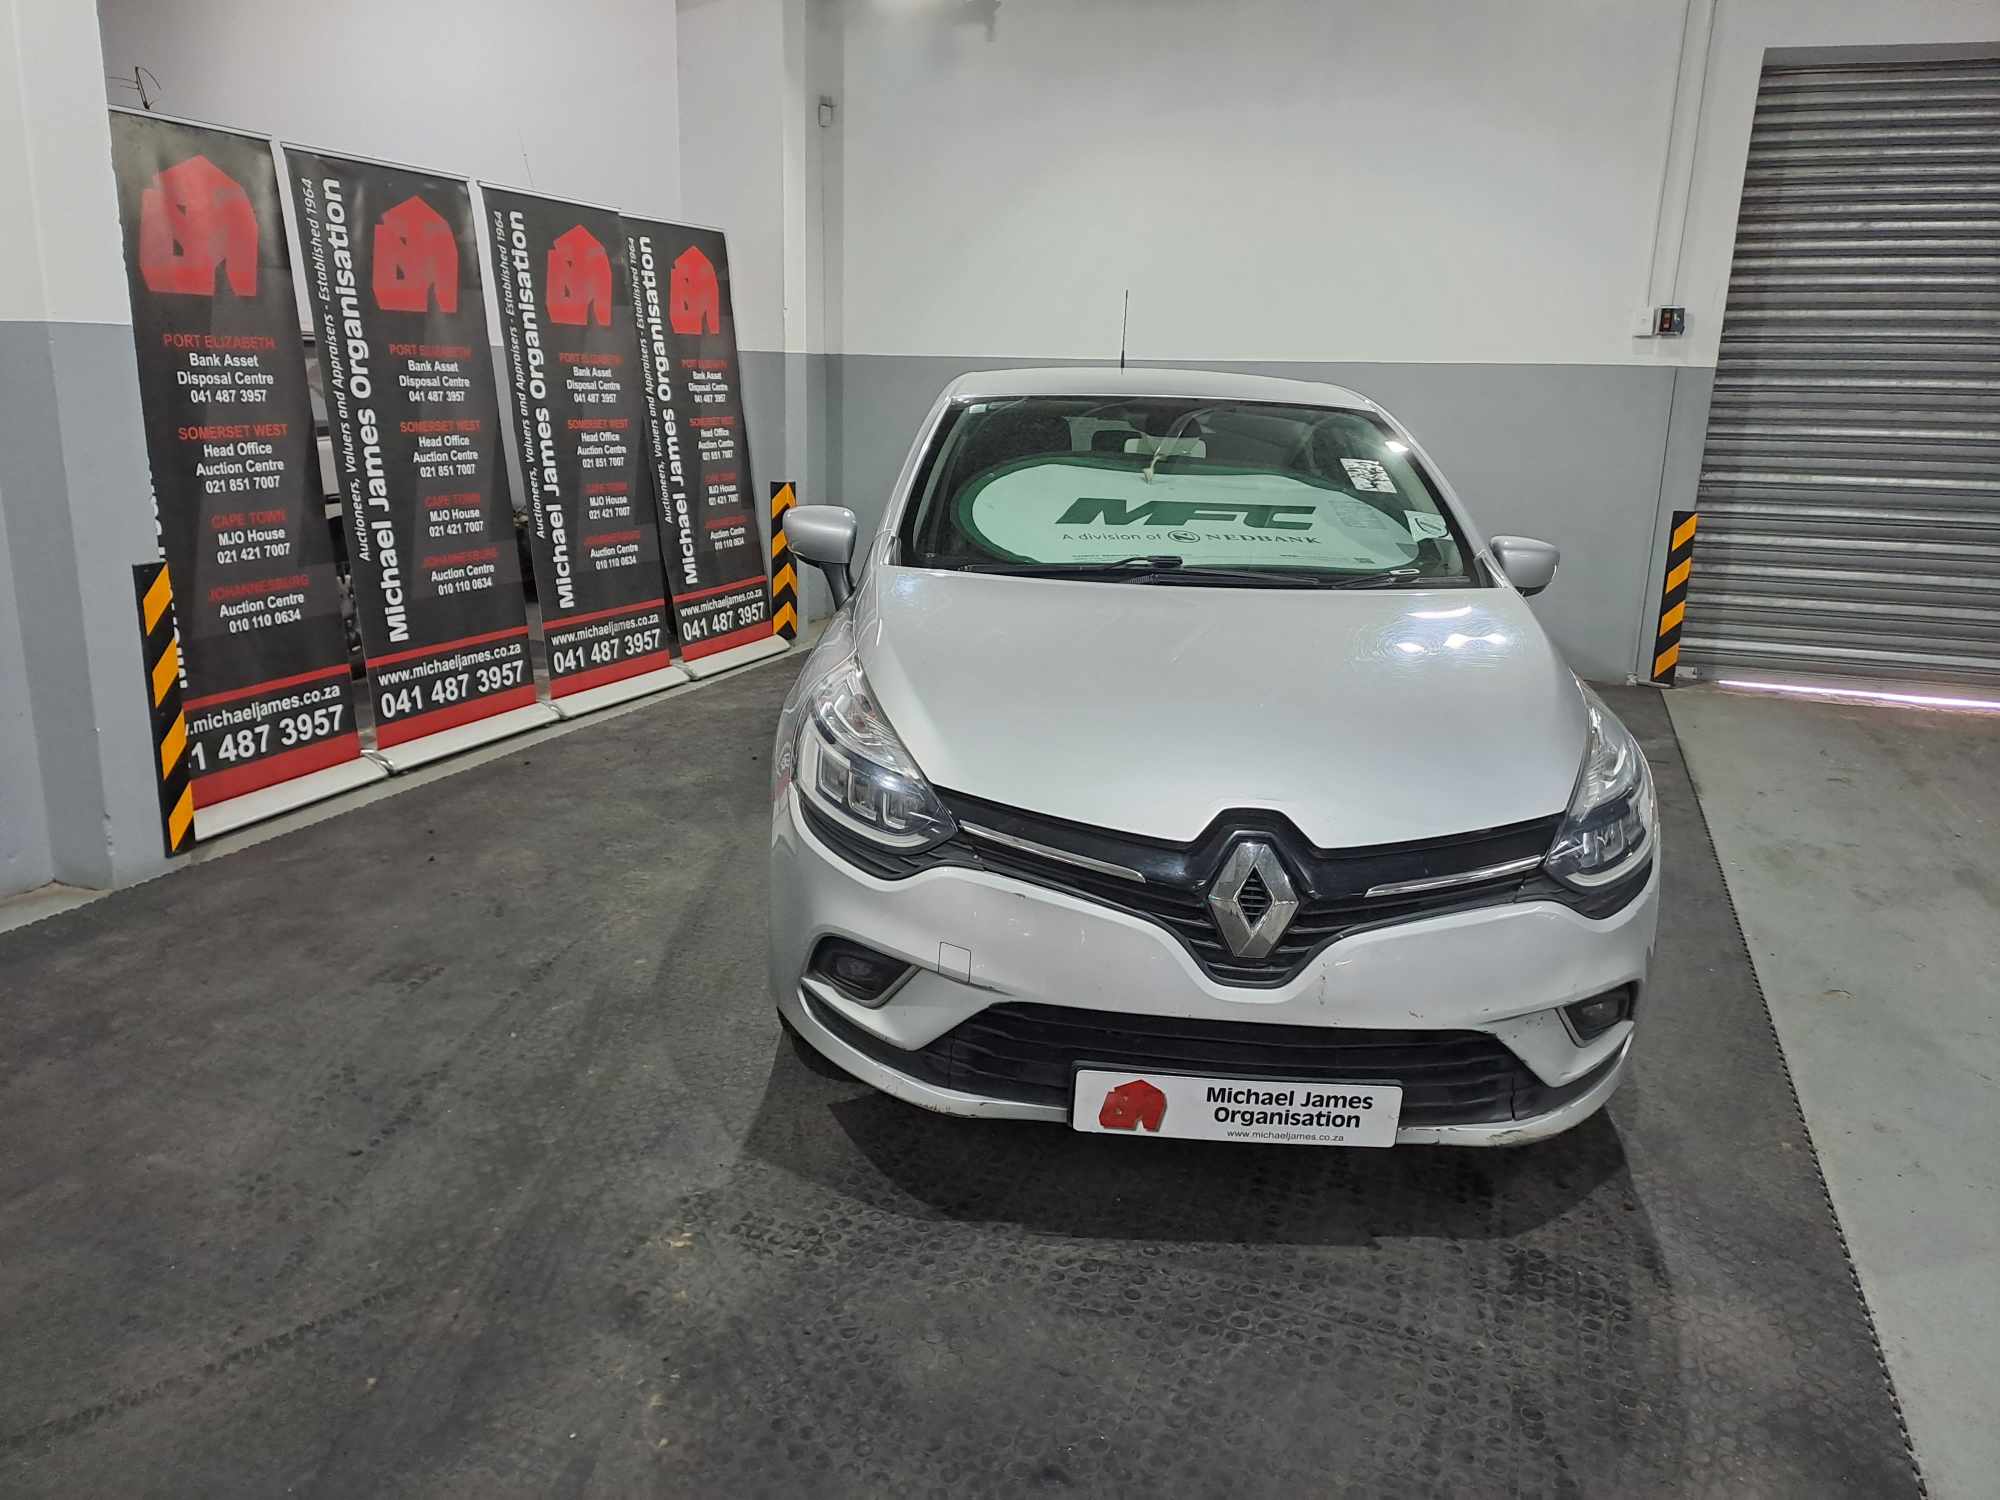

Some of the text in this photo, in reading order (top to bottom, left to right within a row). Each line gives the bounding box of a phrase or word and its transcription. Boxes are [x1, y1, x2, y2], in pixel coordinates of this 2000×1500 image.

[302, 178, 319, 215] 1964
[309, 219, 331, 301] Established
[499, 245, 516, 316] Established
[163, 334, 200, 348] PORT
[324, 314, 345, 388] Appraisers
[189, 353, 259, 367] Bank Asset
[407, 359, 458, 372] Bank Asset
[510, 326, 526, 389] Appraisers
[177, 371, 274, 387] Disposal Centre
[398, 375, 470, 388] Disposal Centre
[573, 366, 591, 377] Bank
[190, 389, 267, 403] 041 487 3957
[566, 380, 621, 391] Disposal Centre
[333, 391, 349, 419] and
[408, 391, 465, 402] 041 487 3957
[517, 391, 530, 416] and
[573, 393, 586, 403] 041
[647, 395, 657, 416] and
[178, 424, 288, 440] SOMERSET WEST
[418, 434, 470, 447] Head Office
[523, 420, 535, 463] Valuers
[581, 431, 620, 442] Head Office
[203, 441, 273, 457] Head Office
[340, 423, 357, 473] Valuers
[413, 450, 478, 463] Auction Centre
[536, 407, 559, 496] James
[577, 444, 626, 456] Auction Centre
[662, 408, 684, 486] James
[196, 459, 285, 476] Auction Centre
[358, 408, 390, 512] James
[420, 466, 435, 477] 021
[456, 464, 475, 475] 7007
[205, 475, 280, 494] 021 851 7007
[529, 466, 545, 539] Auctioneers,
[605, 495, 627, 505] House
[351, 478, 371, 561] Auctioneers,
[429, 508, 480, 522] MJO House
[589, 509, 600, 520] 021
[1055, 497, 1316, 530] MFC
[218, 529, 285, 546] MJO House
[429, 521, 484, 537] 021 421 7007
[672, 493, 699, 585] Michael
[1062, 532, 1321, 545] A division of NEDBANK
[217, 543, 291, 565] 021 421 7007
[546, 504, 575, 610] Michael
[591, 543, 639, 558] Auction Centre
[371, 520, 409, 643] Michael
[431, 564, 495, 582] Auction Centre
[438, 584, 454, 596] 010
[455, 581, 471, 593] 110
[219, 593, 305, 618] Auction Centre
[680, 589, 762, 616] www.michaeljames.co.za
[229, 608, 302, 633] 010 110 0634
[551, 613, 659, 646] www.michaeljames.co.za
[683, 602, 764, 641] 041 487 3957
[553, 628, 661, 674] 041 487 3957
[378, 643, 521, 686] www.michaeljames.co.za
[381, 660, 524, 718] 041 487 3957
[218, 724, 270, 762] 487
[279, 704, 344, 746] 3957
[1206, 1087, 1374, 1110] Michael James
[1214, 1106, 1361, 1129] Organisation
[1227, 1129, 1344, 1142] www.michaeljames.co.za
